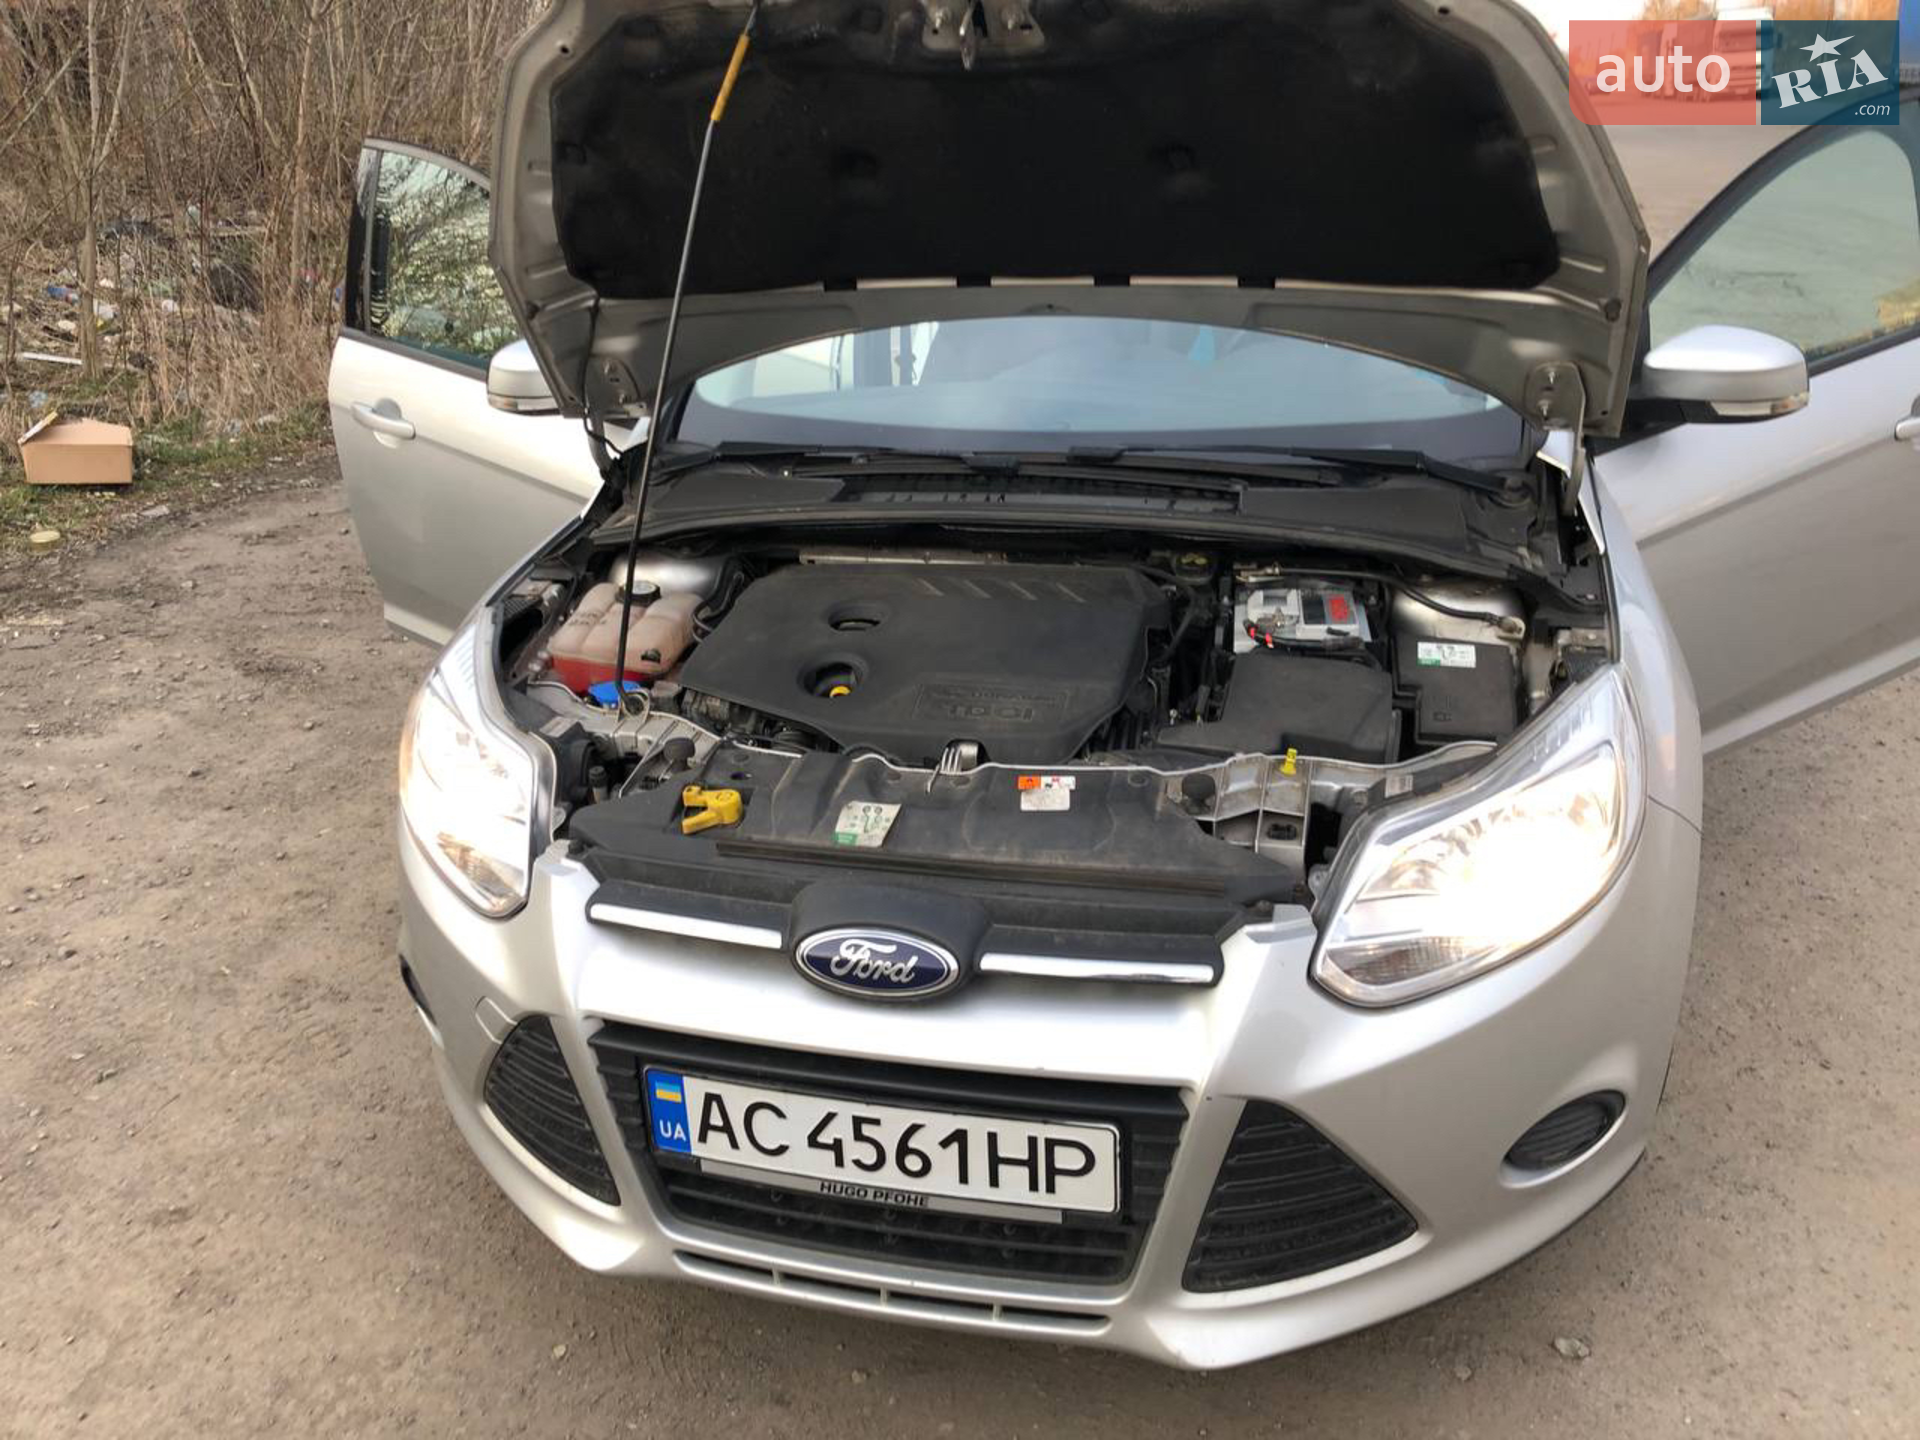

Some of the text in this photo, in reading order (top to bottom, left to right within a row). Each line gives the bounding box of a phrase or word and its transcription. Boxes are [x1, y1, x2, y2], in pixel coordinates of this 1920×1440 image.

[830, 938, 920, 979] Ford
[659, 1119, 687, 1142] UA
[698, 1092, 1096, 1193] AC 4561 HP
[820, 1181, 868, 1199] HUGO
